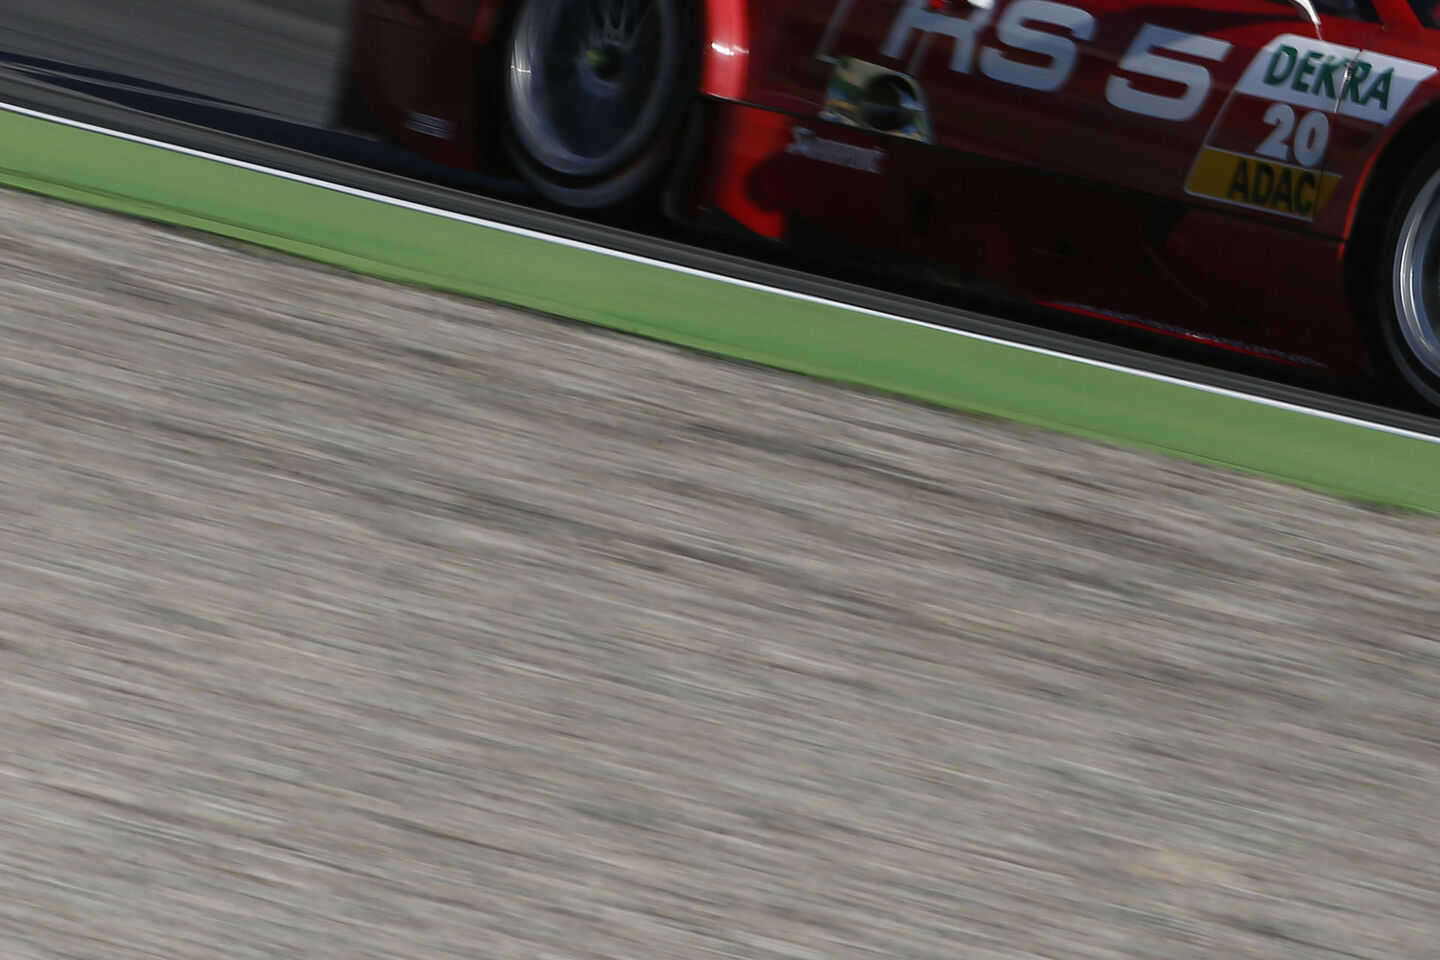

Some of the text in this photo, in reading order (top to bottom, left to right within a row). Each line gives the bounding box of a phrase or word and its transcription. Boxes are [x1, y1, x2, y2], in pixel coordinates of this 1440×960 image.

[1105, 22, 1235, 122] 5
[1263, 43, 1394, 111] DEKRA
[1254, 103, 1330, 167] 20
[1227, 157, 1317, 215] ADAC
